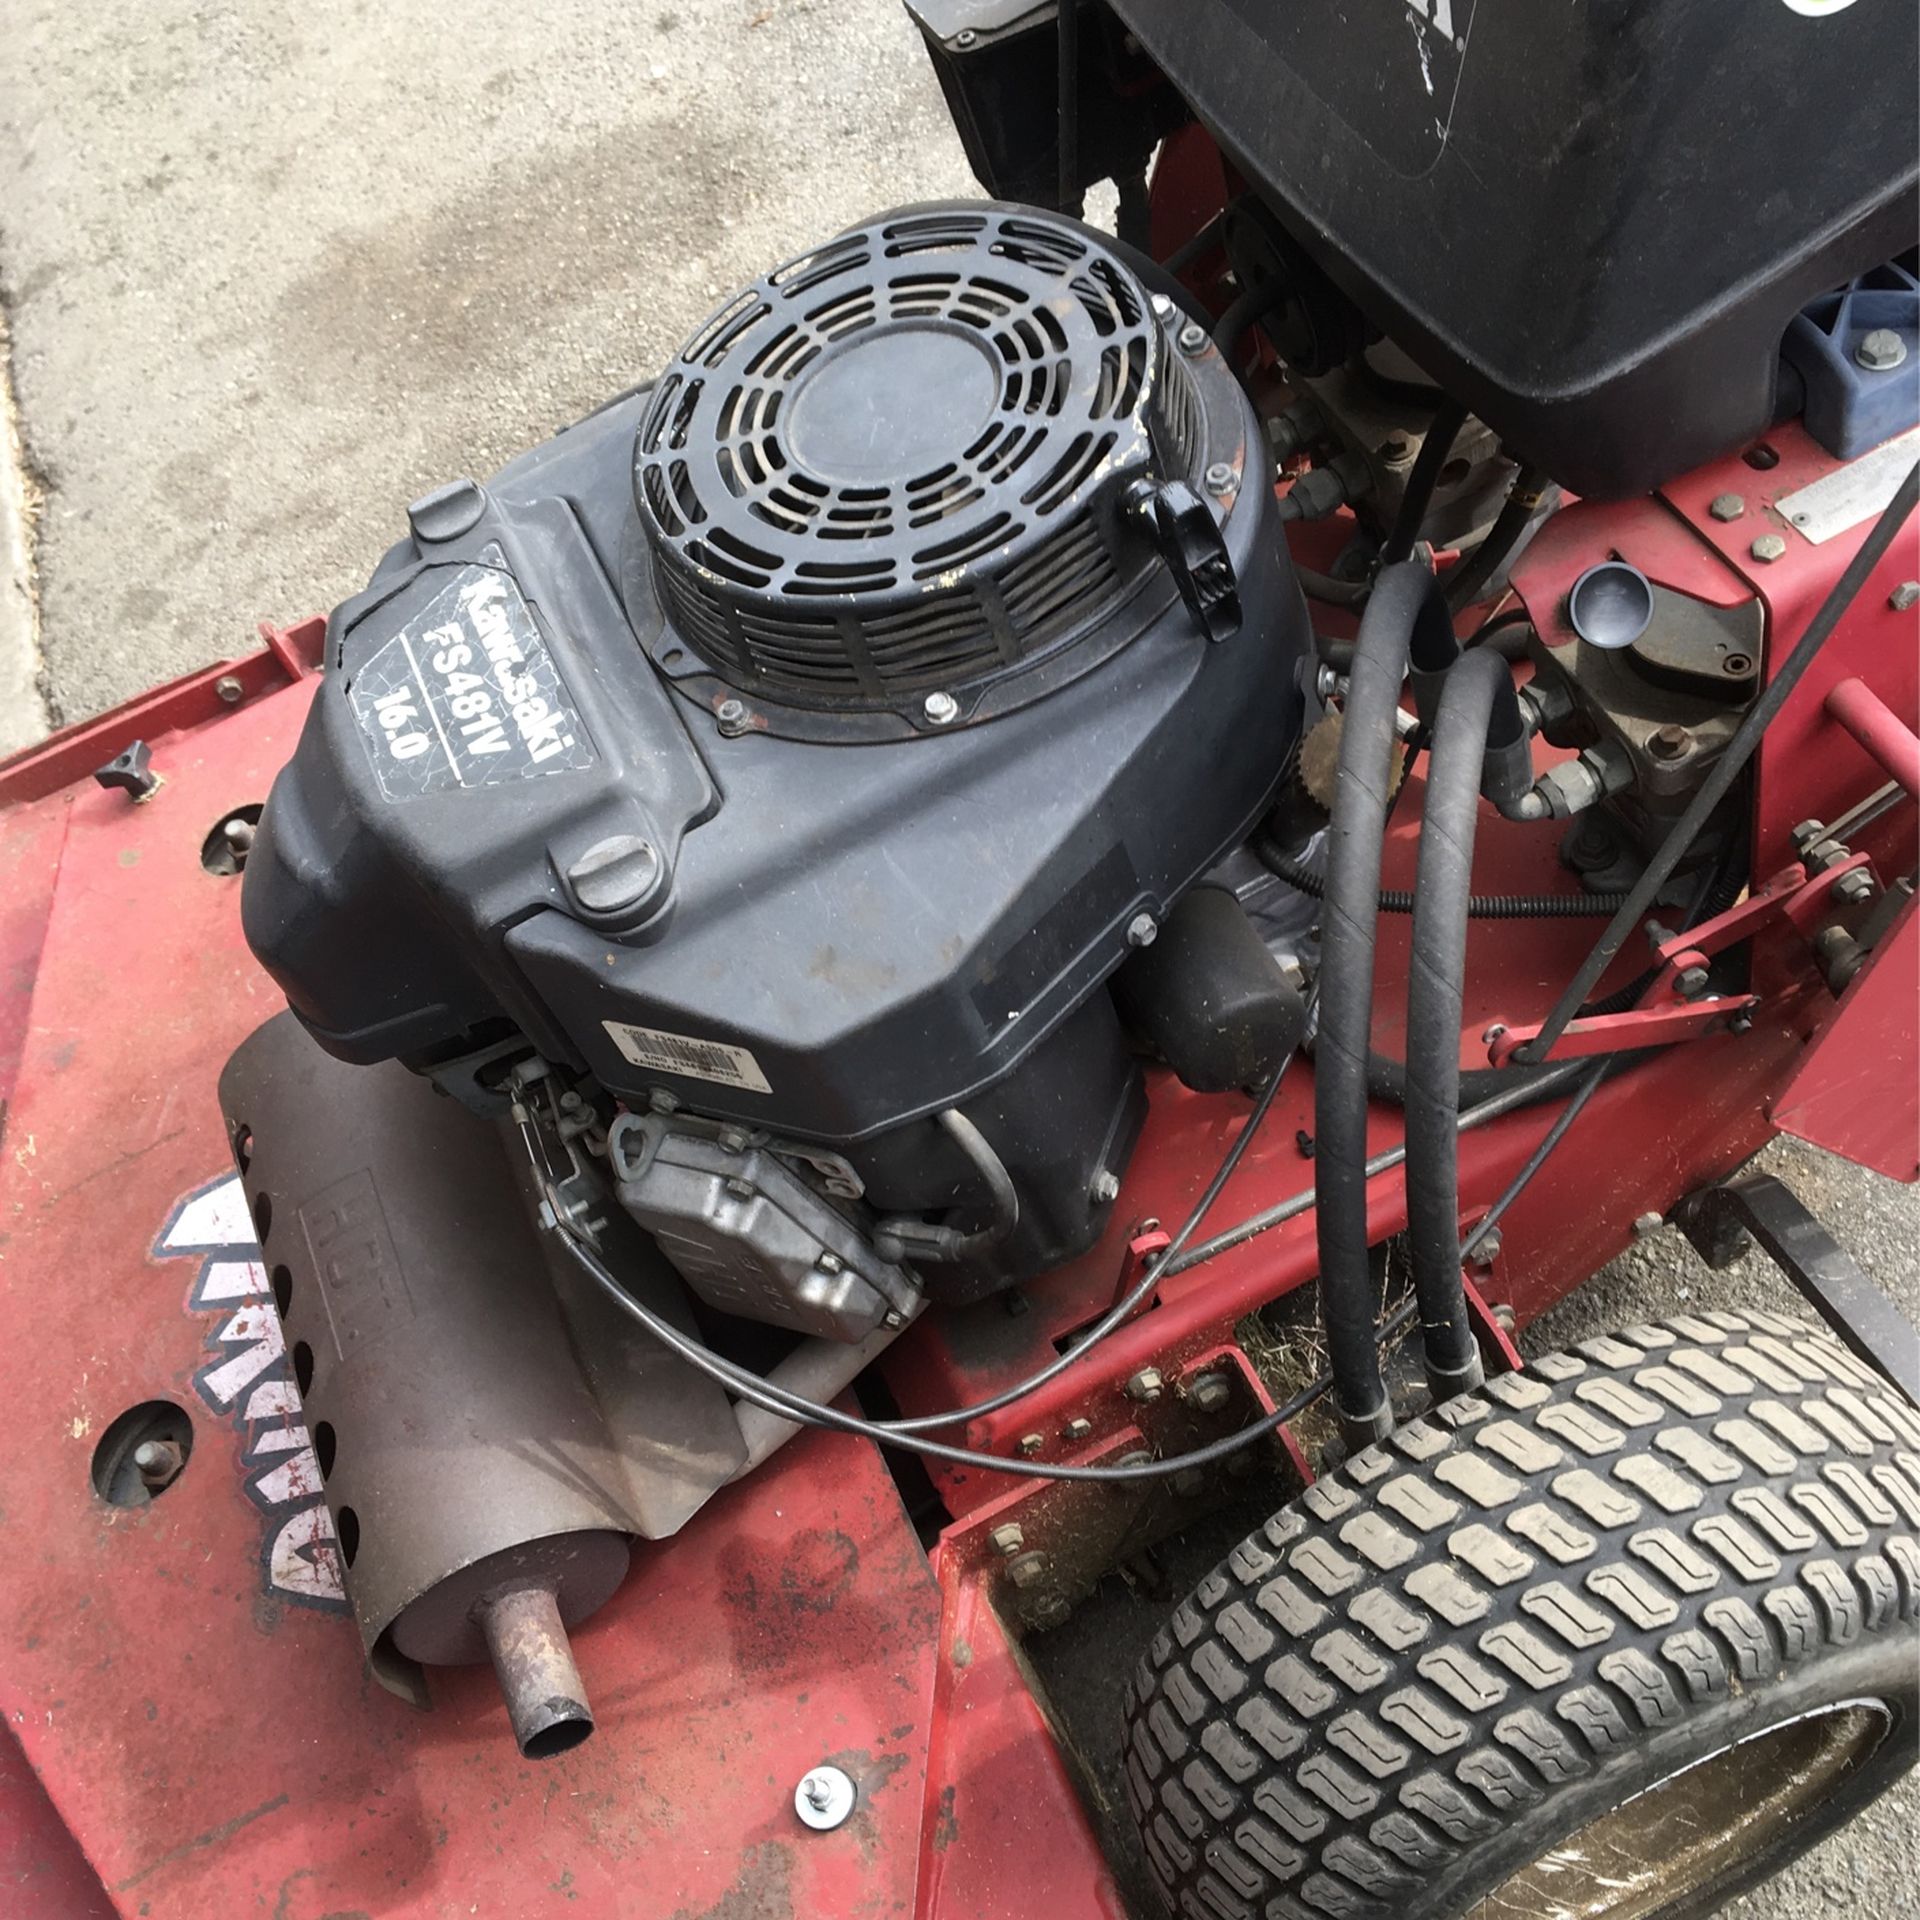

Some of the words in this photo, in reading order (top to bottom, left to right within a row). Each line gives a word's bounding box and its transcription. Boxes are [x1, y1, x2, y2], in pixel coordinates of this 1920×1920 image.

[422, 622, 511, 755] FS481V
[460, 571, 575, 764] Kawasaki
[373, 686, 430, 760] 16.0
[633, 1058, 683, 1072] KAWASAKI
